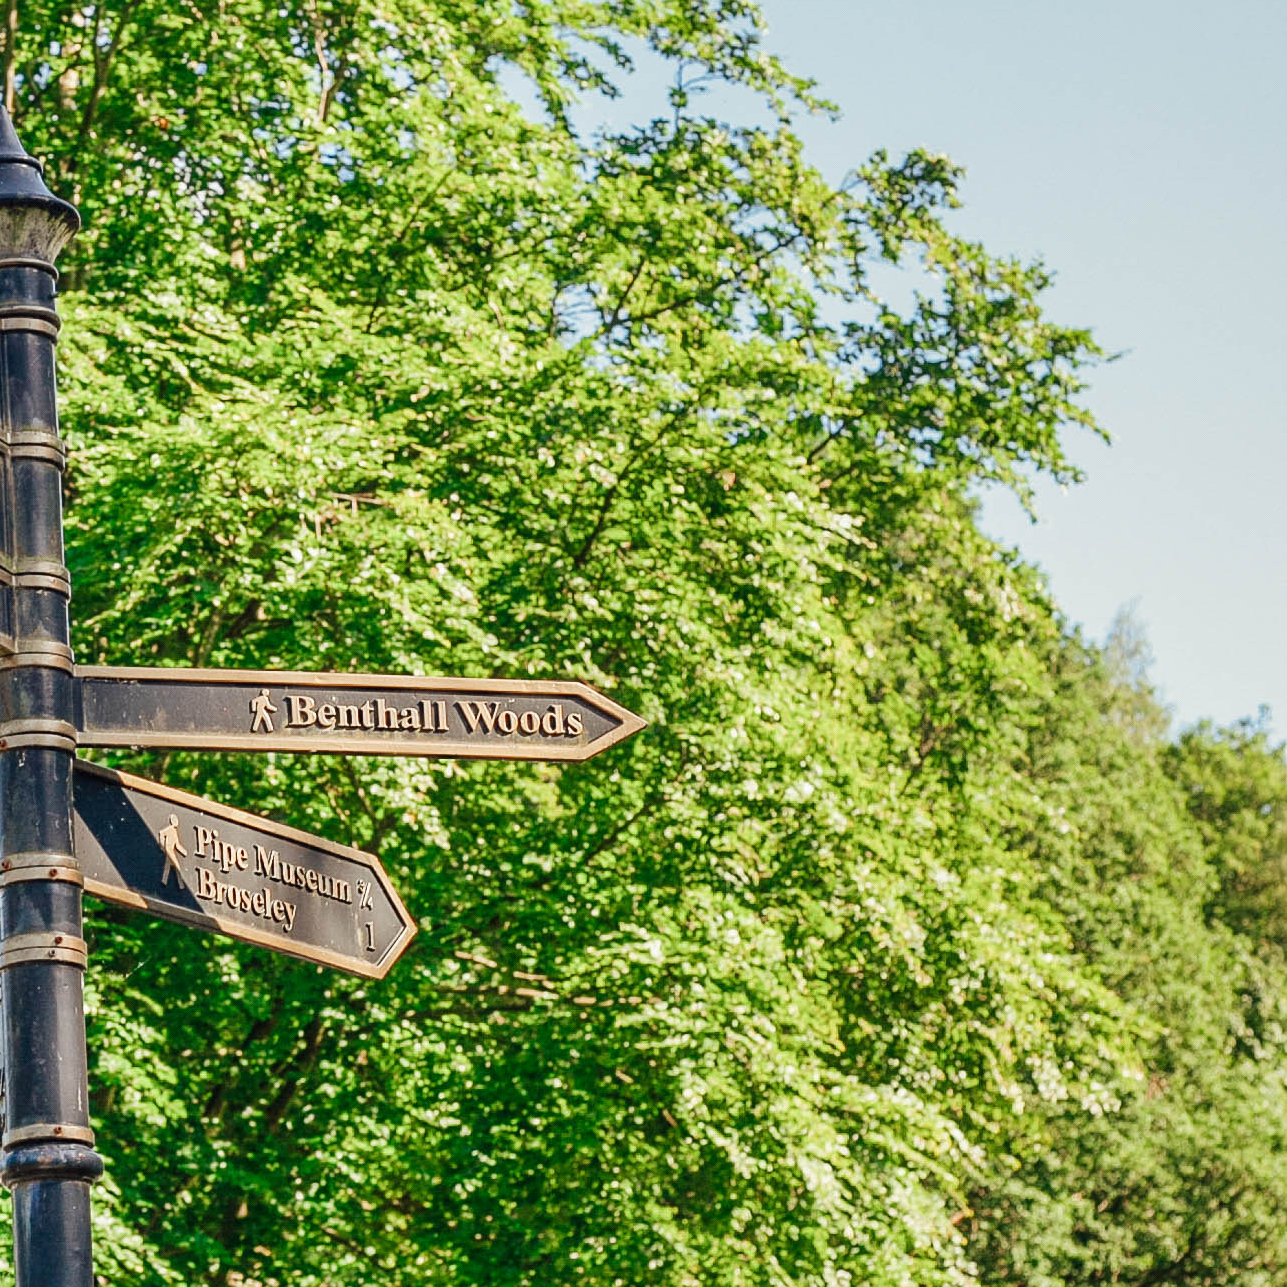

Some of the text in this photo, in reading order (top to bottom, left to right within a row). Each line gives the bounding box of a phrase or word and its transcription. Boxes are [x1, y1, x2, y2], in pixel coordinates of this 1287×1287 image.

[284, 694, 583, 738] Benthall Woods
[193, 824, 249, 874] Pipe
[253, 844, 353, 905] Museum
[195, 866, 376, 953] Broseley 1
